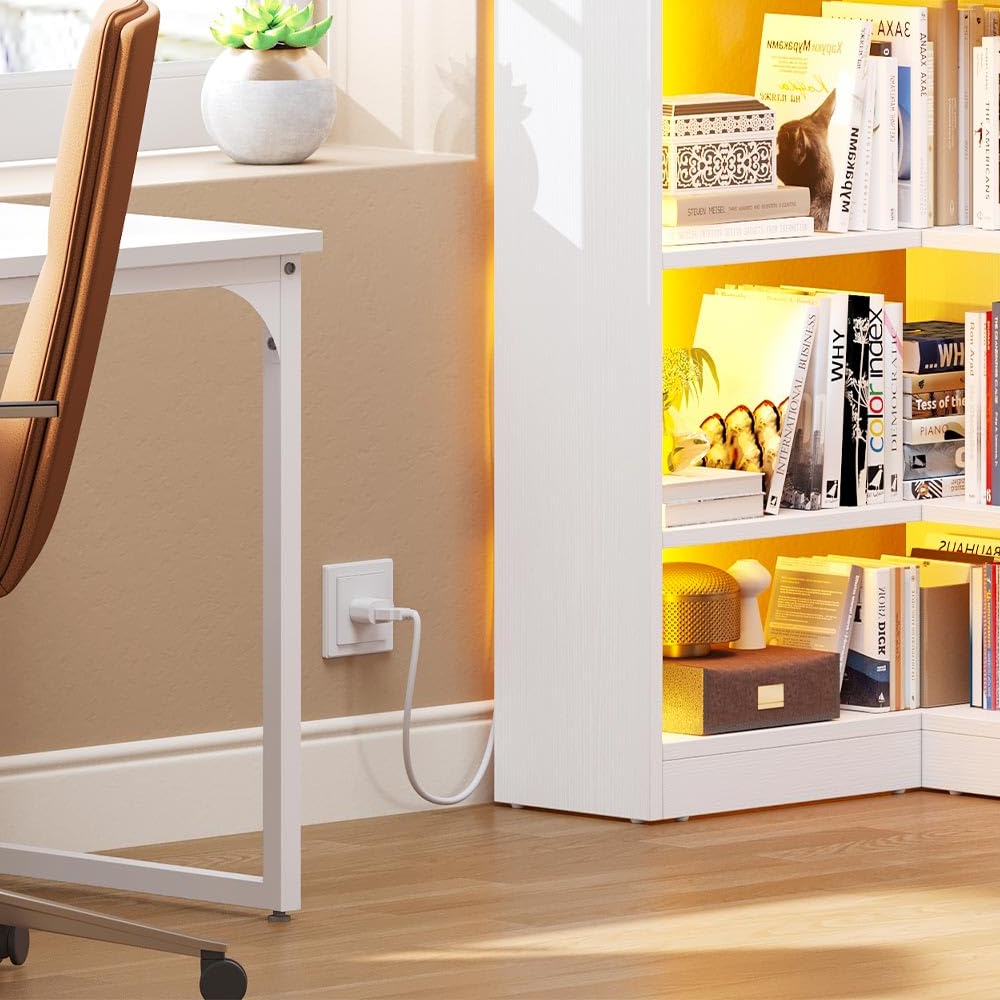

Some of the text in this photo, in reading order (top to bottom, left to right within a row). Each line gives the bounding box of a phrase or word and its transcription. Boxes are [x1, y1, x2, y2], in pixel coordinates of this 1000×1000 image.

[687, 205, 725, 217] STEVEN MEISEL
[831, 329, 845, 382] WHY
[776, 313, 817, 475] INTERNATIONAL BUSINESS
[868, 308, 884, 453] color index
[890, 333, 898, 452] DEMOCRATIC
[916, 398, 937, 411] Tess
[939, 396, 950, 409] of
[920, 424, 949, 436] PIANO
[878, 622, 886, 655] DICK
